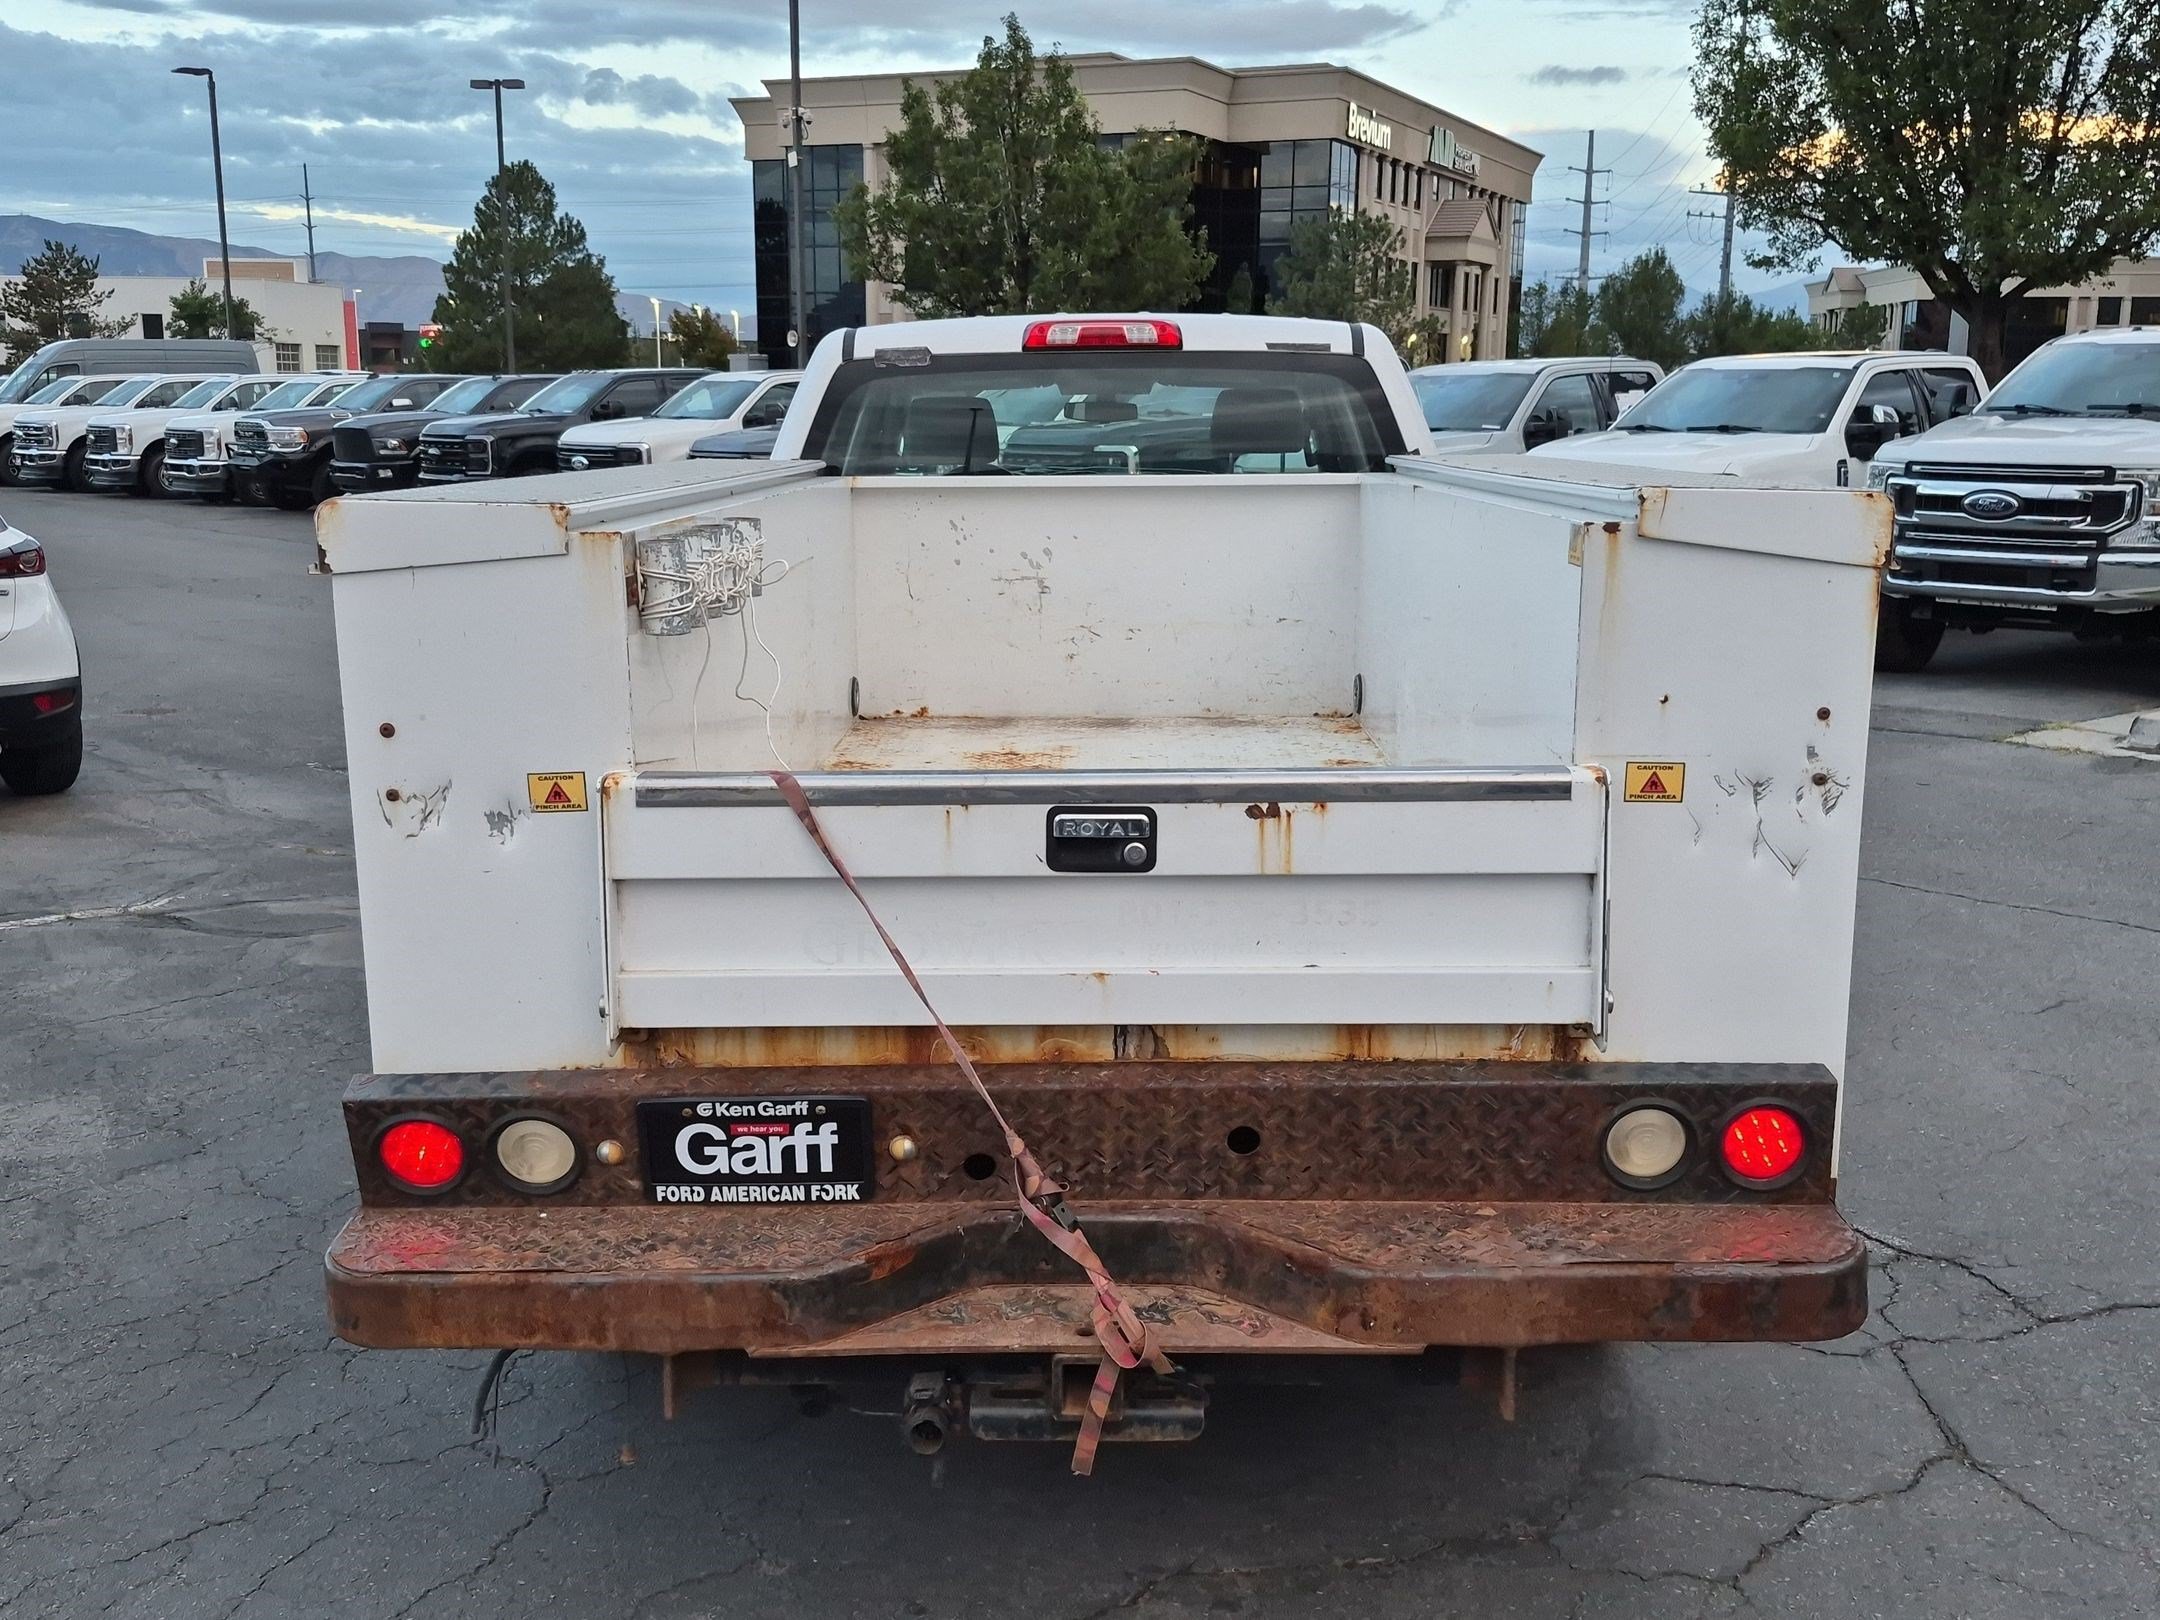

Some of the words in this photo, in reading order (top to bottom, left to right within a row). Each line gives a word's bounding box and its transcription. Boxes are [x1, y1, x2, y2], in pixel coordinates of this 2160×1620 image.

[1348, 101, 1391, 150] Brevium
[1976, 498, 2005, 511] Ford
[1063, 822, 1140, 836] ROYAL
[715, 1102, 756, 1117] Ken
[757, 1101, 809, 1117] Garff
[737, 1125, 748, 1133] we
[750, 1124, 767, 1133] hear
[768, 1125, 784, 1134] you
[674, 1122, 839, 1175] Garff
[655, 1185, 705, 1202] FORD
[710, 1184, 806, 1202] AMERICAN
[811, 1183, 861, 1201] FORK
